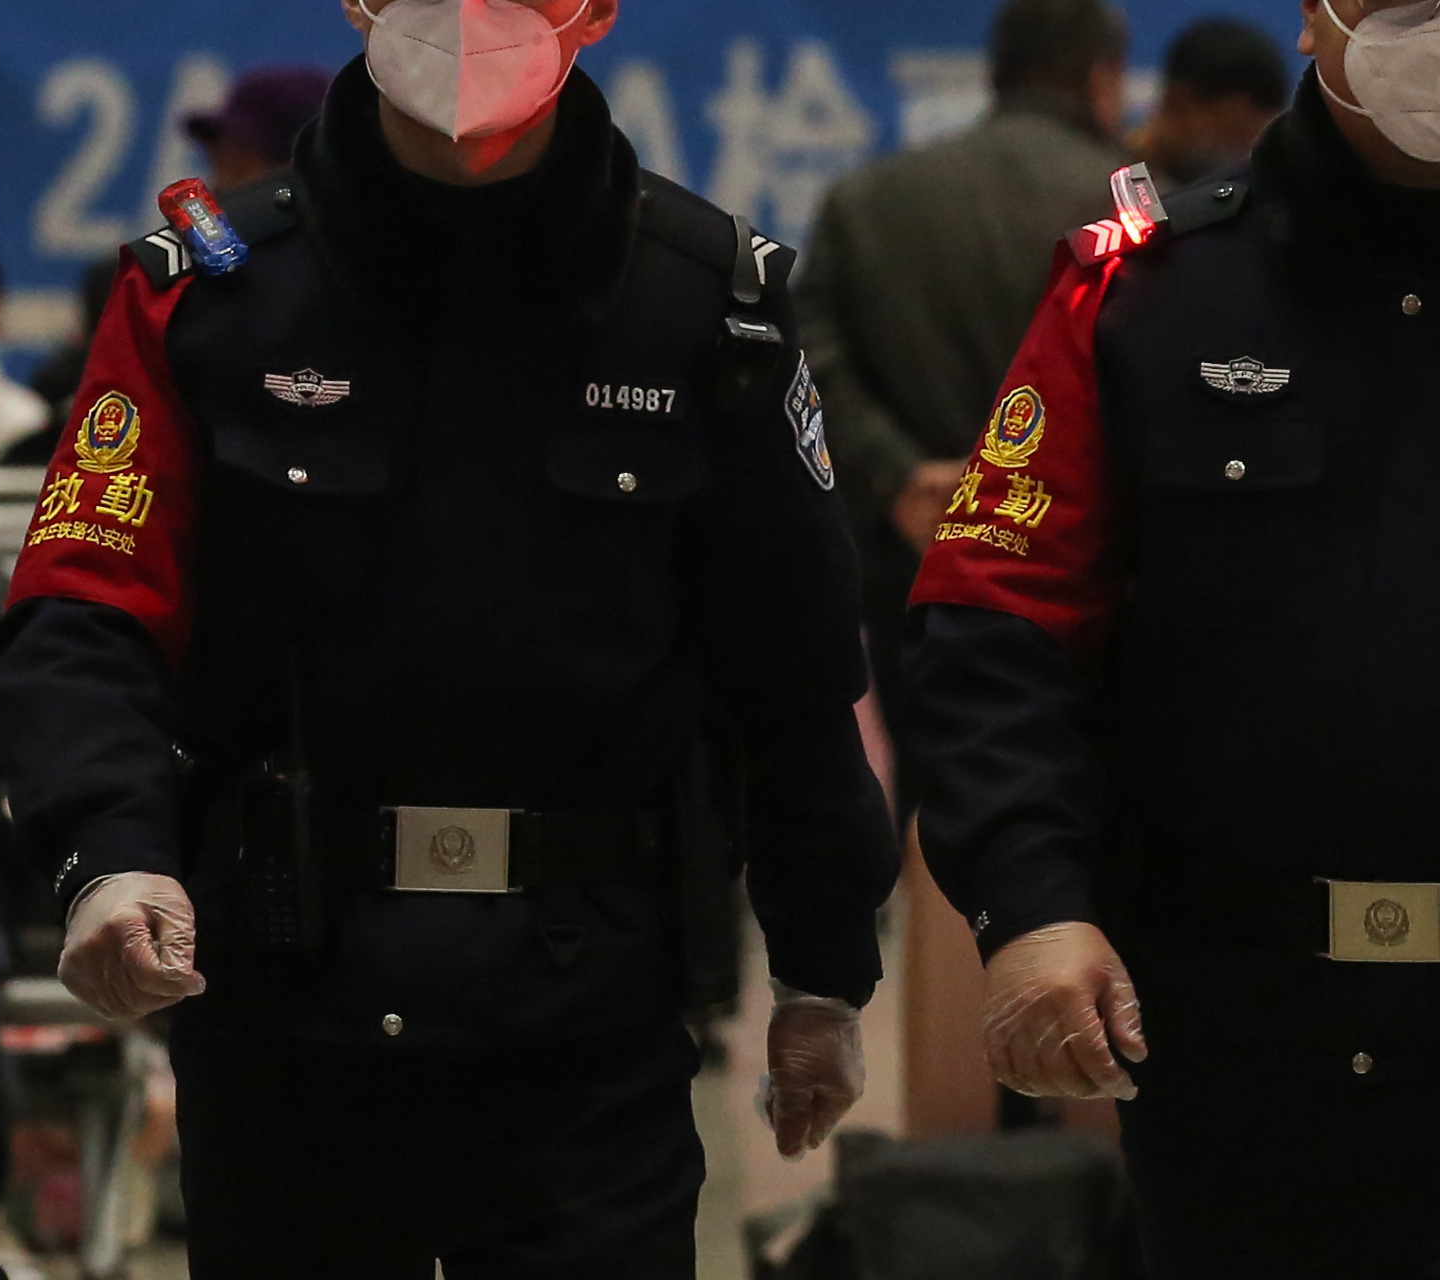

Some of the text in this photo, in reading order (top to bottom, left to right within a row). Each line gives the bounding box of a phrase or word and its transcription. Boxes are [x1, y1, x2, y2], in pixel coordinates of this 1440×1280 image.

[187, 202, 219, 237] POLICE
[585, 383, 676, 413] 014987
[38, 472, 154, 527] 执勤
[945, 462, 1052, 528] 执勤
